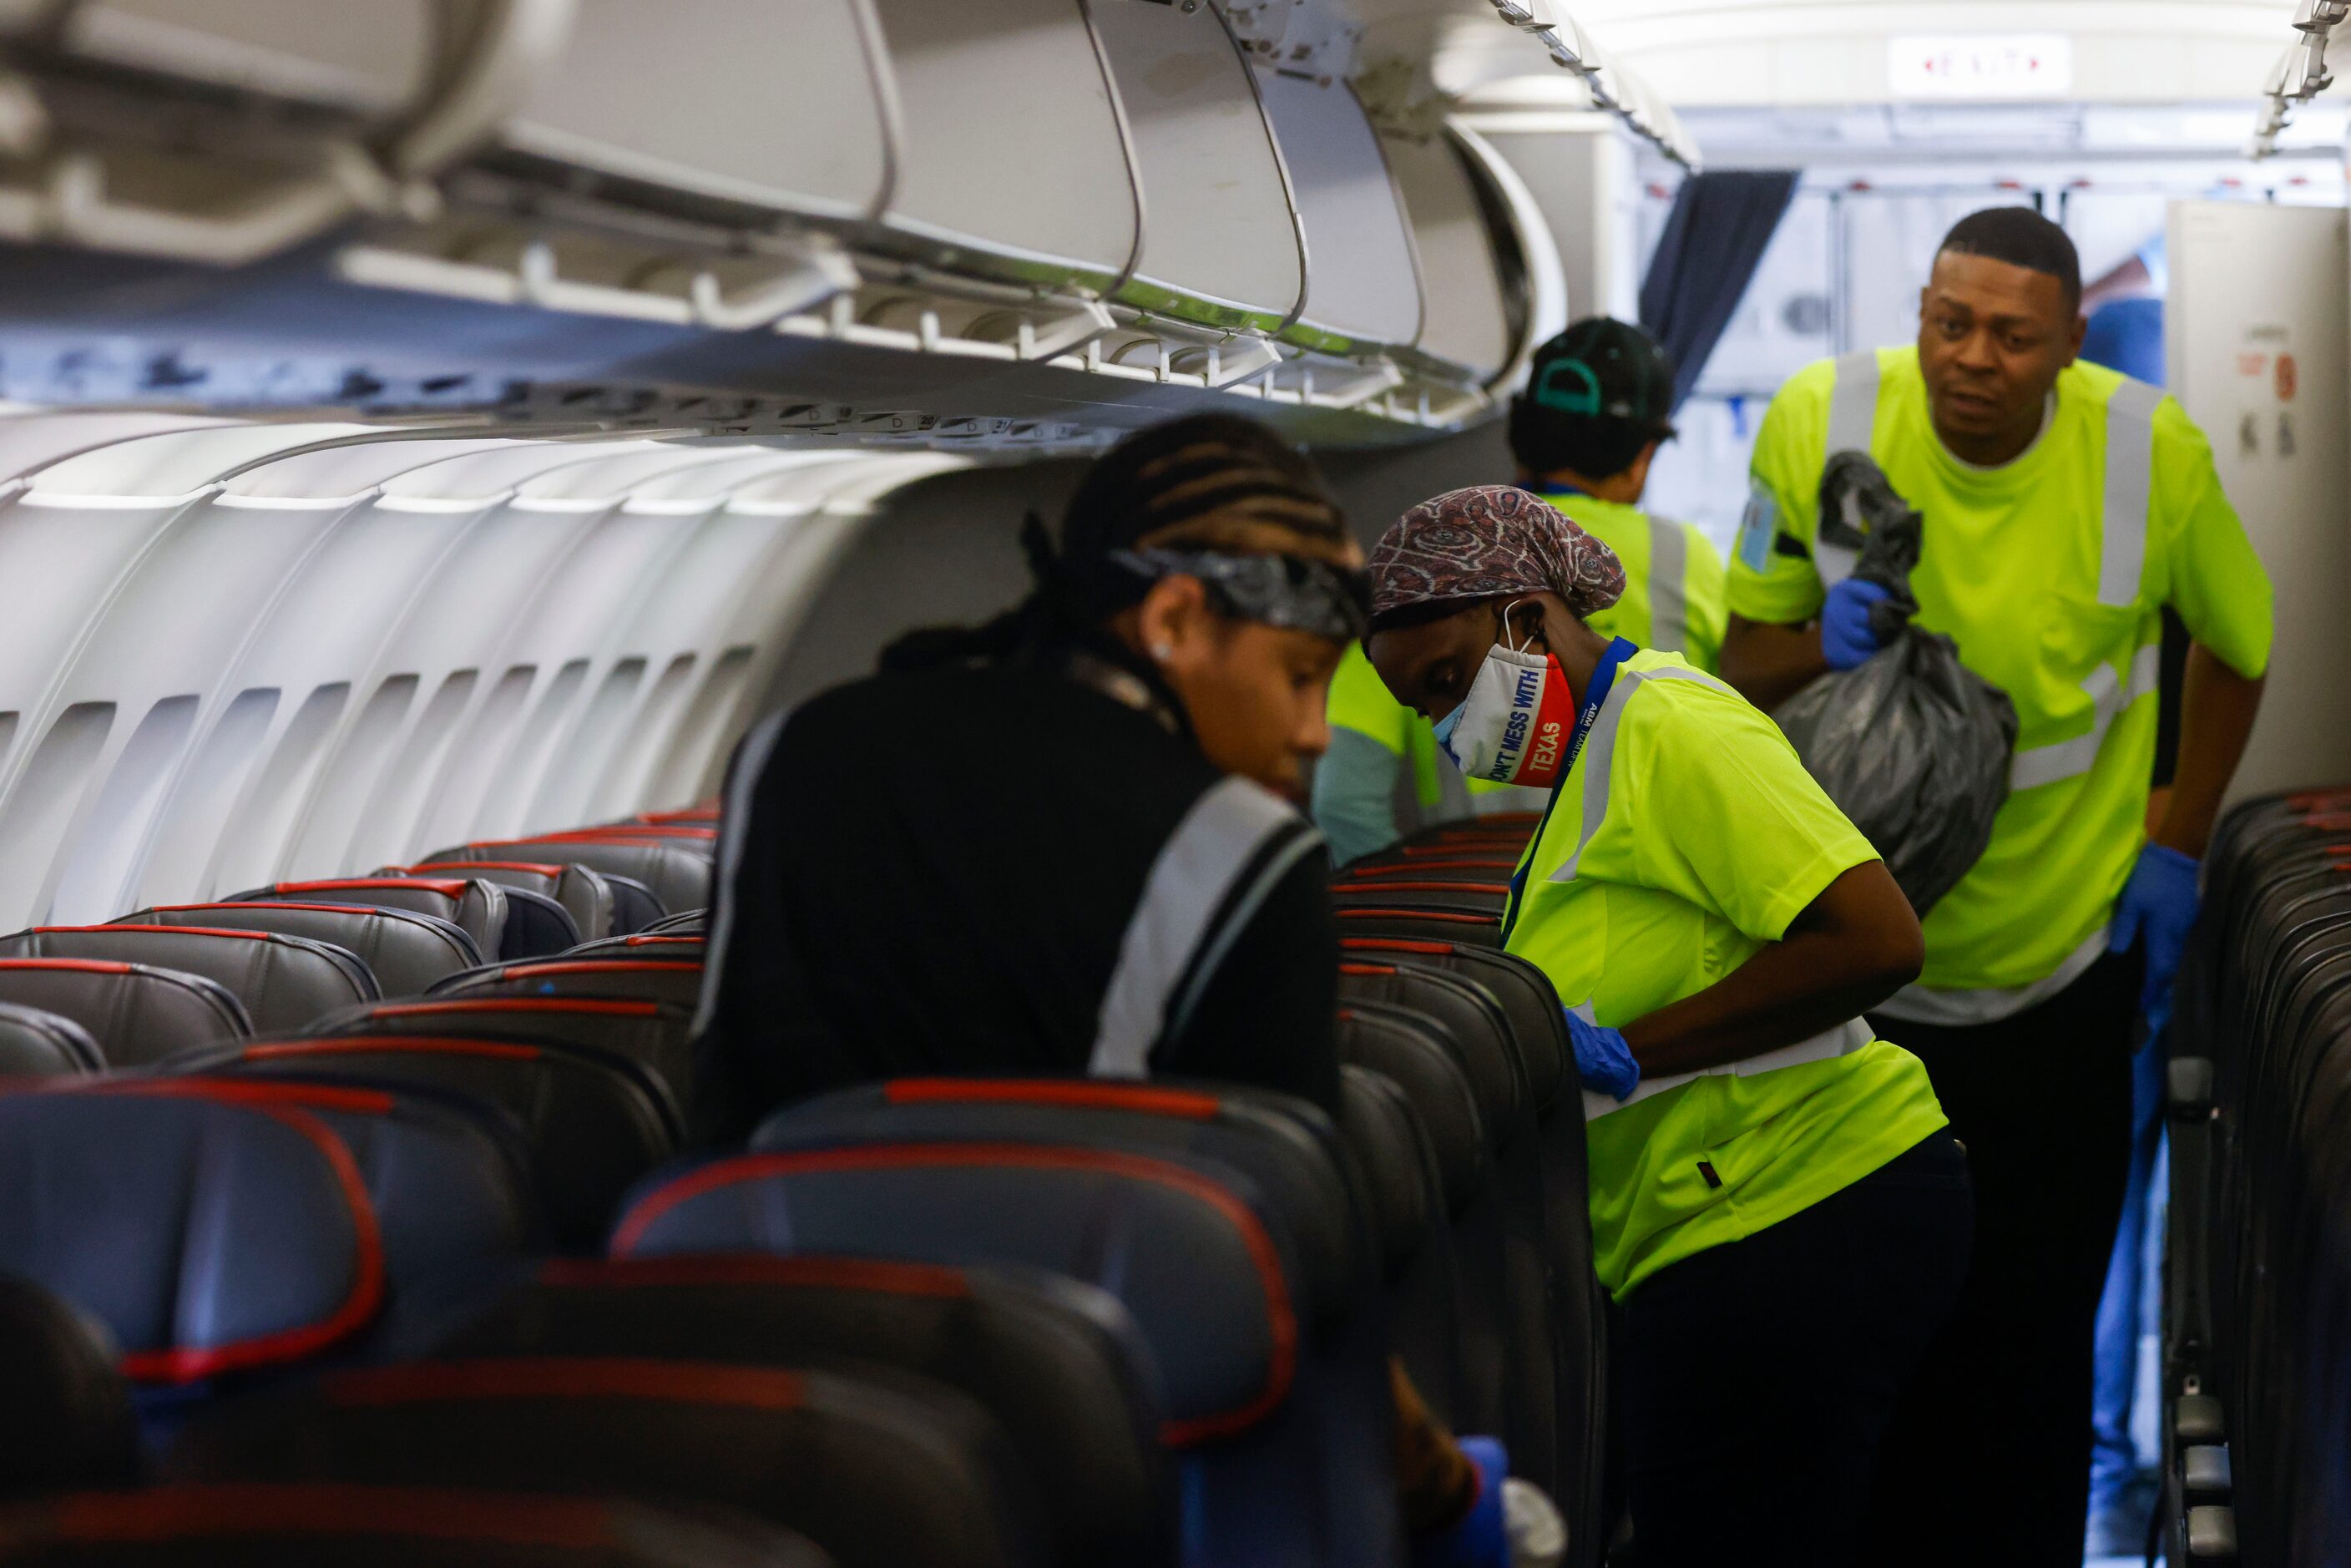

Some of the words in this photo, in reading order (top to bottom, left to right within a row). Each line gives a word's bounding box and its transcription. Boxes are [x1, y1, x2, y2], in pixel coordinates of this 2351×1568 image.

[892, 418, 902, 428] D
[920, 416, 934, 425] 20
[967, 422, 977, 432] D
[995, 421, 1008, 430] 21
[1513, 669, 1539, 708] WITH
[1584, 702, 1598, 727] ABM
[1501, 711, 1529, 752] MESS
[1529, 722, 1561, 771] TEXAS
